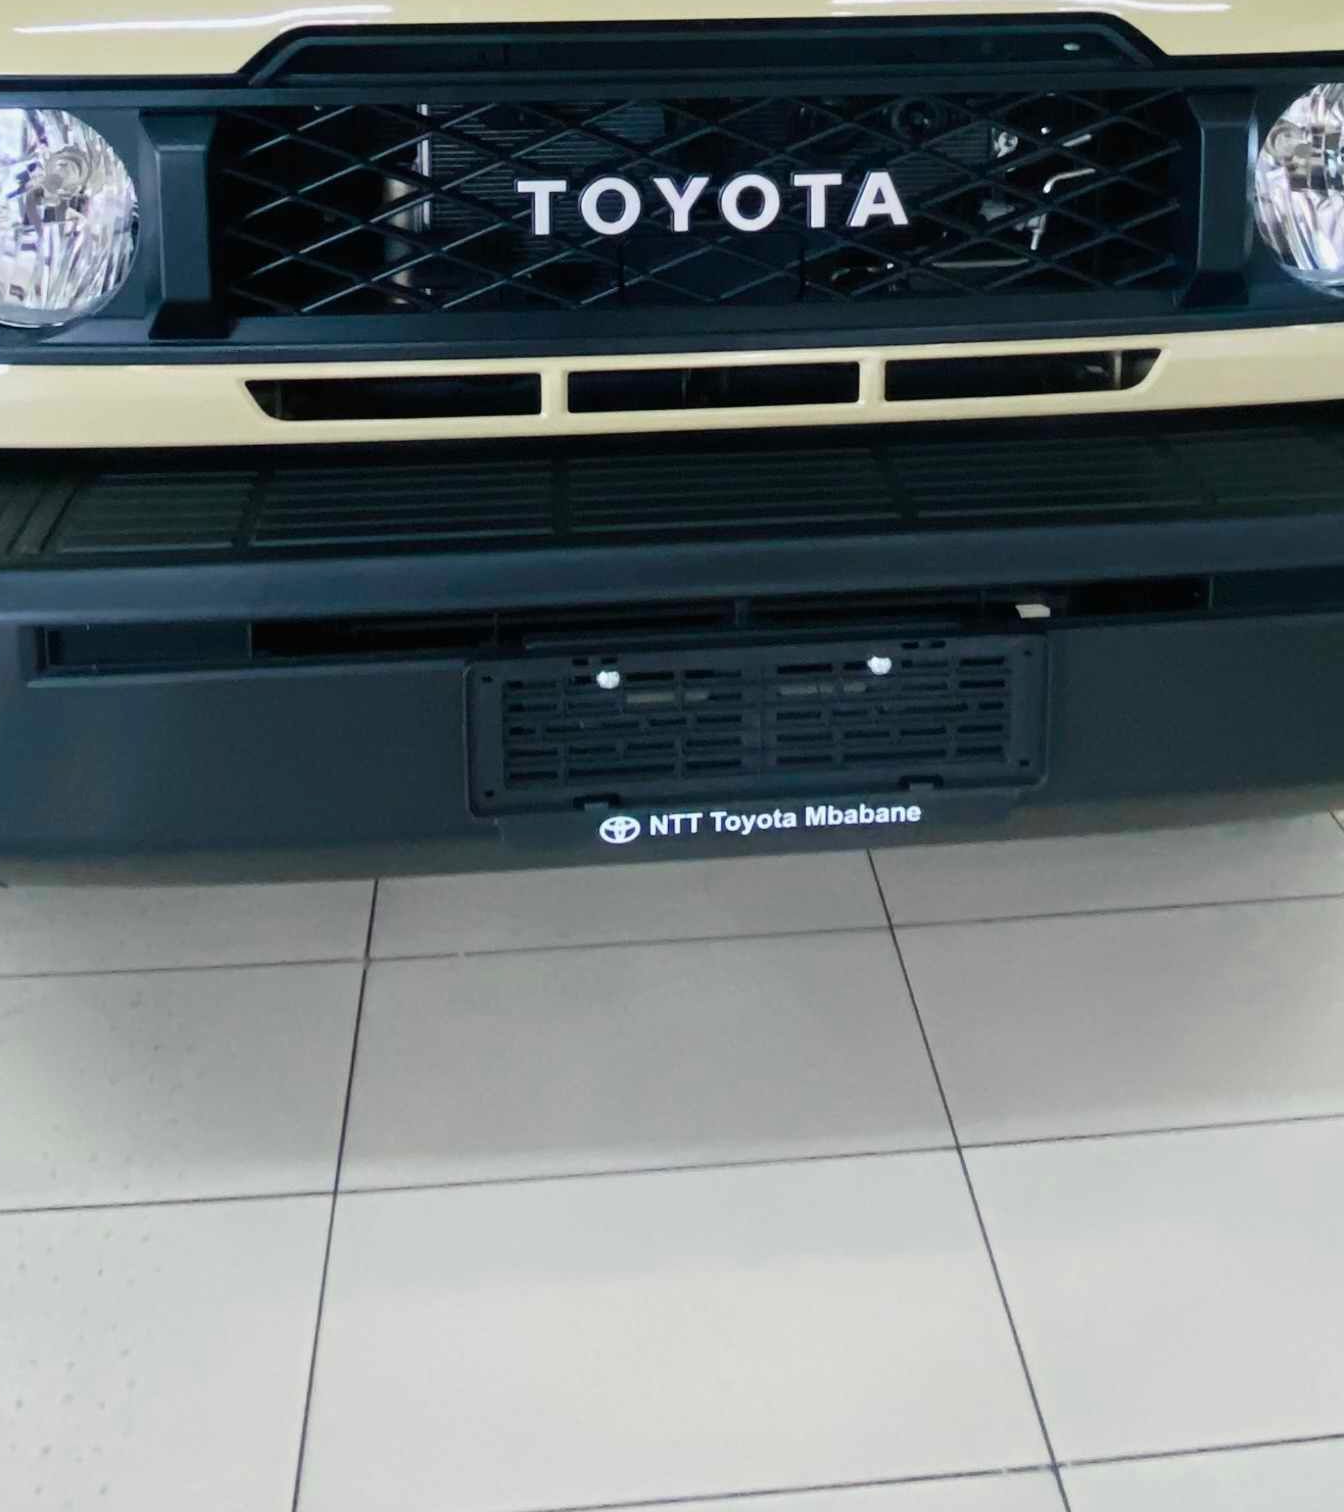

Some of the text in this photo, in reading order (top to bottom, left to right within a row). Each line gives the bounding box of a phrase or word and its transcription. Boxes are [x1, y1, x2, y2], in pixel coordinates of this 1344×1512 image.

[515, 171, 909, 236] TOYOTA
[649, 803, 922, 836] NTT Toyota Mbabane
